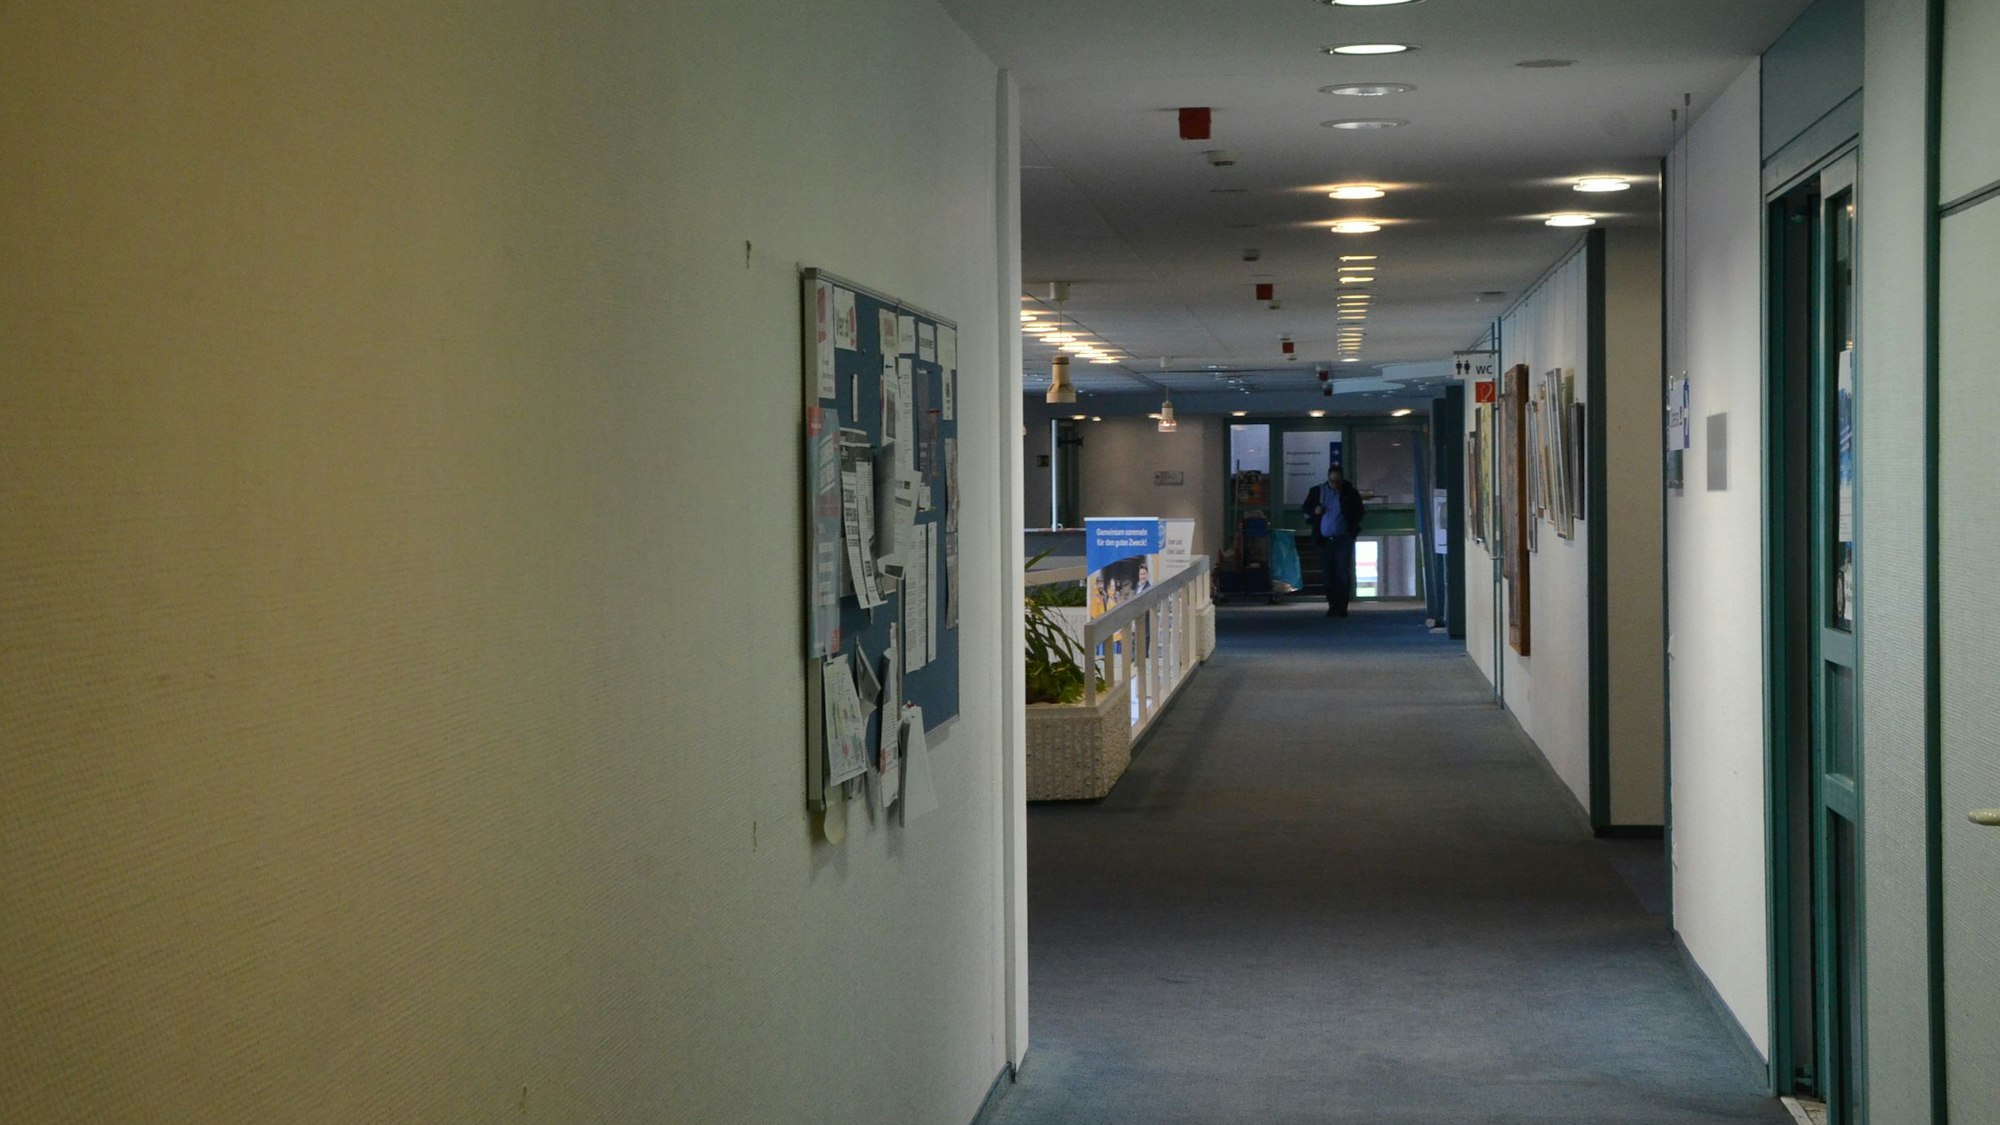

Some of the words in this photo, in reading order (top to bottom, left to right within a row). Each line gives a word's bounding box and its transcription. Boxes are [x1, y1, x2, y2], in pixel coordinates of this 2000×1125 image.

[1476, 365, 1493, 374] WC
[1105, 538, 1115, 546] den
[1115, 539, 1128, 548] guten
[1128, 538, 1147, 546] Zweck!
